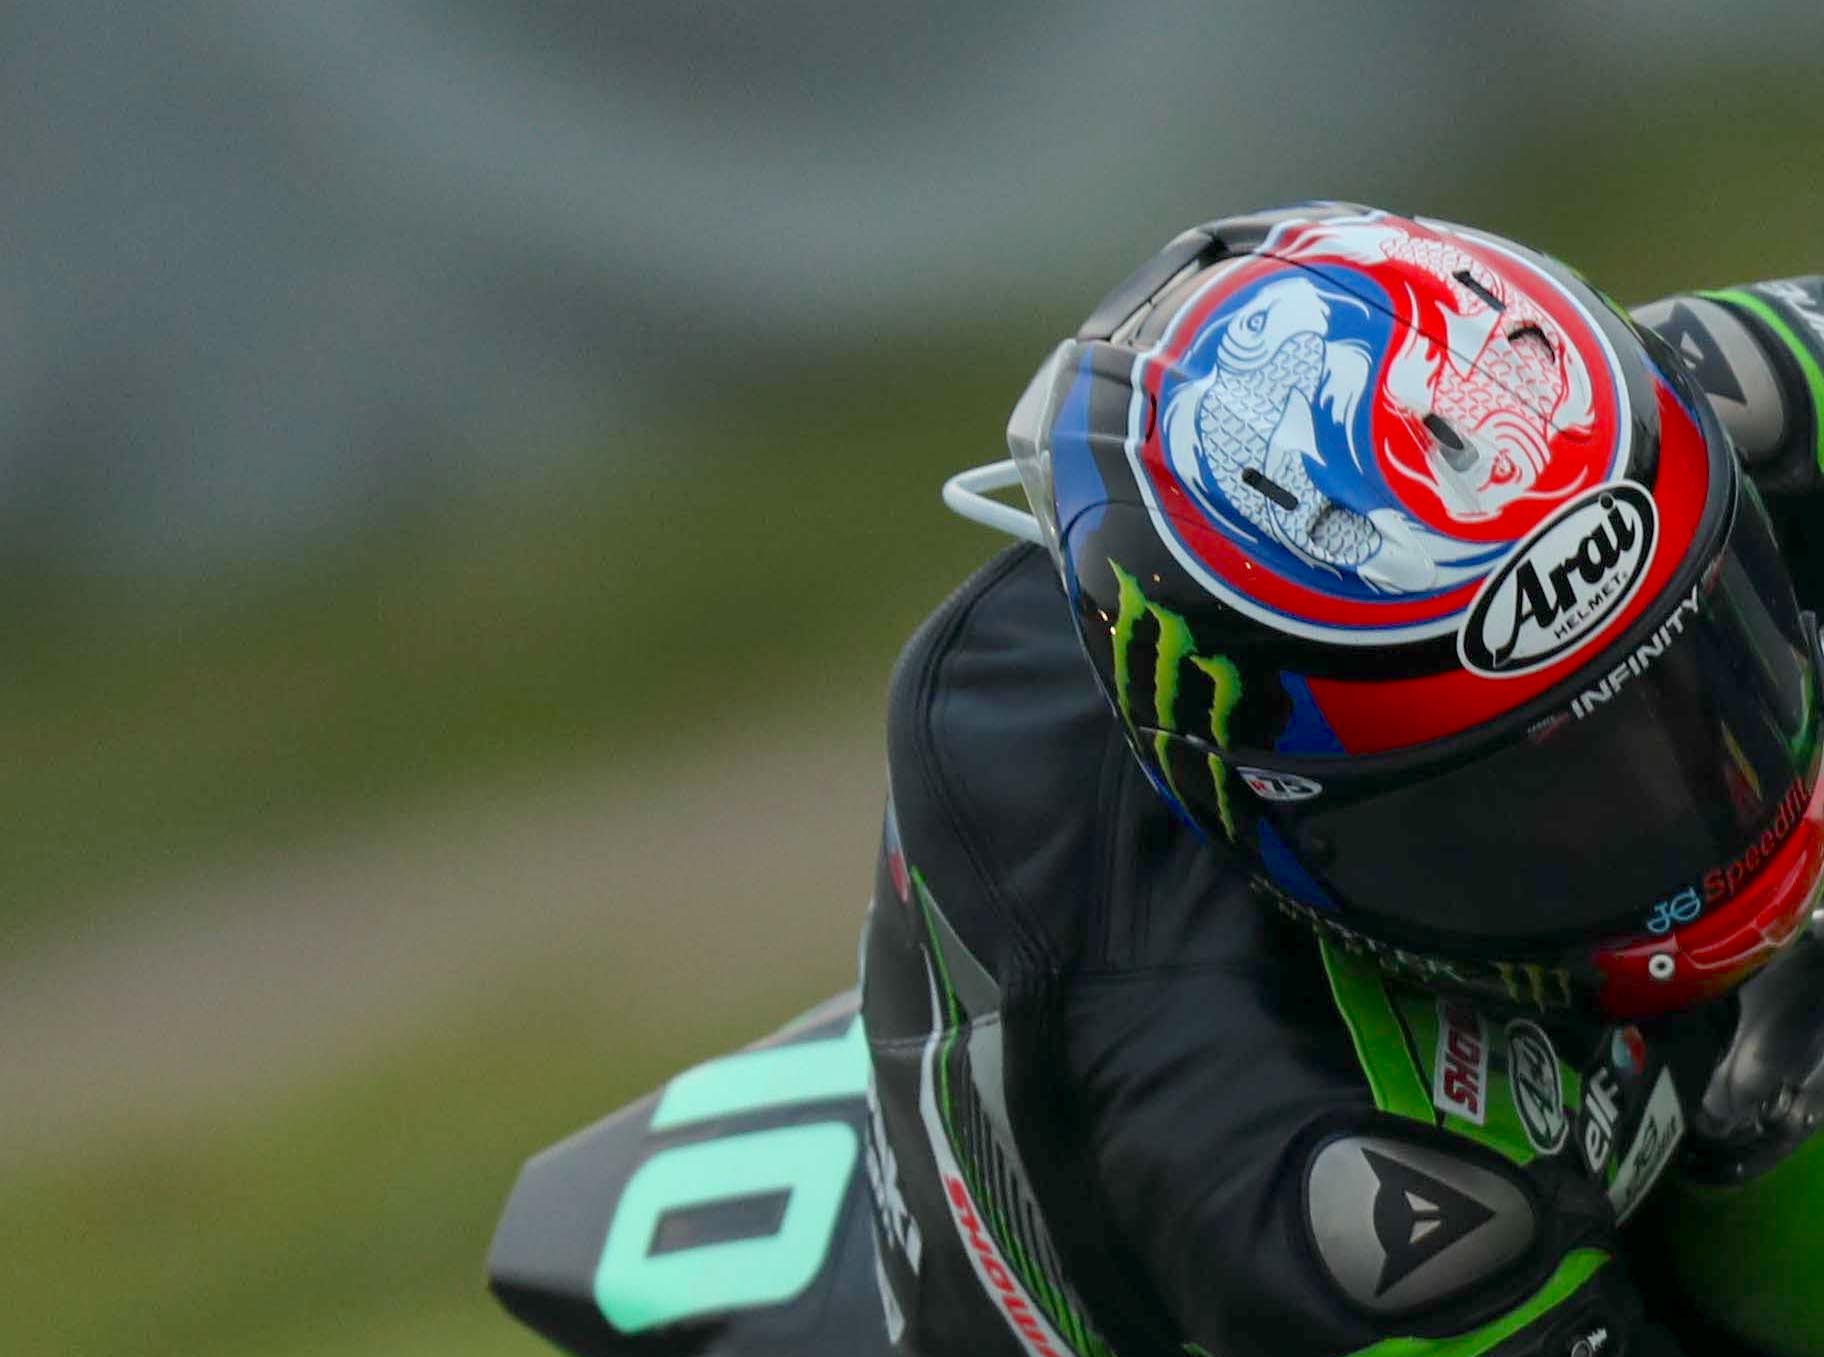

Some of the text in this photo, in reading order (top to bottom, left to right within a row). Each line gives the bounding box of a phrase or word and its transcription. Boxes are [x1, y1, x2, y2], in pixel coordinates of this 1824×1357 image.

[1493, 493, 1636, 667] Arai
[1554, 574, 1622, 640] HELMET
[1571, 584, 1700, 719] INFINITY
[593, 1013, 874, 1334] 10
